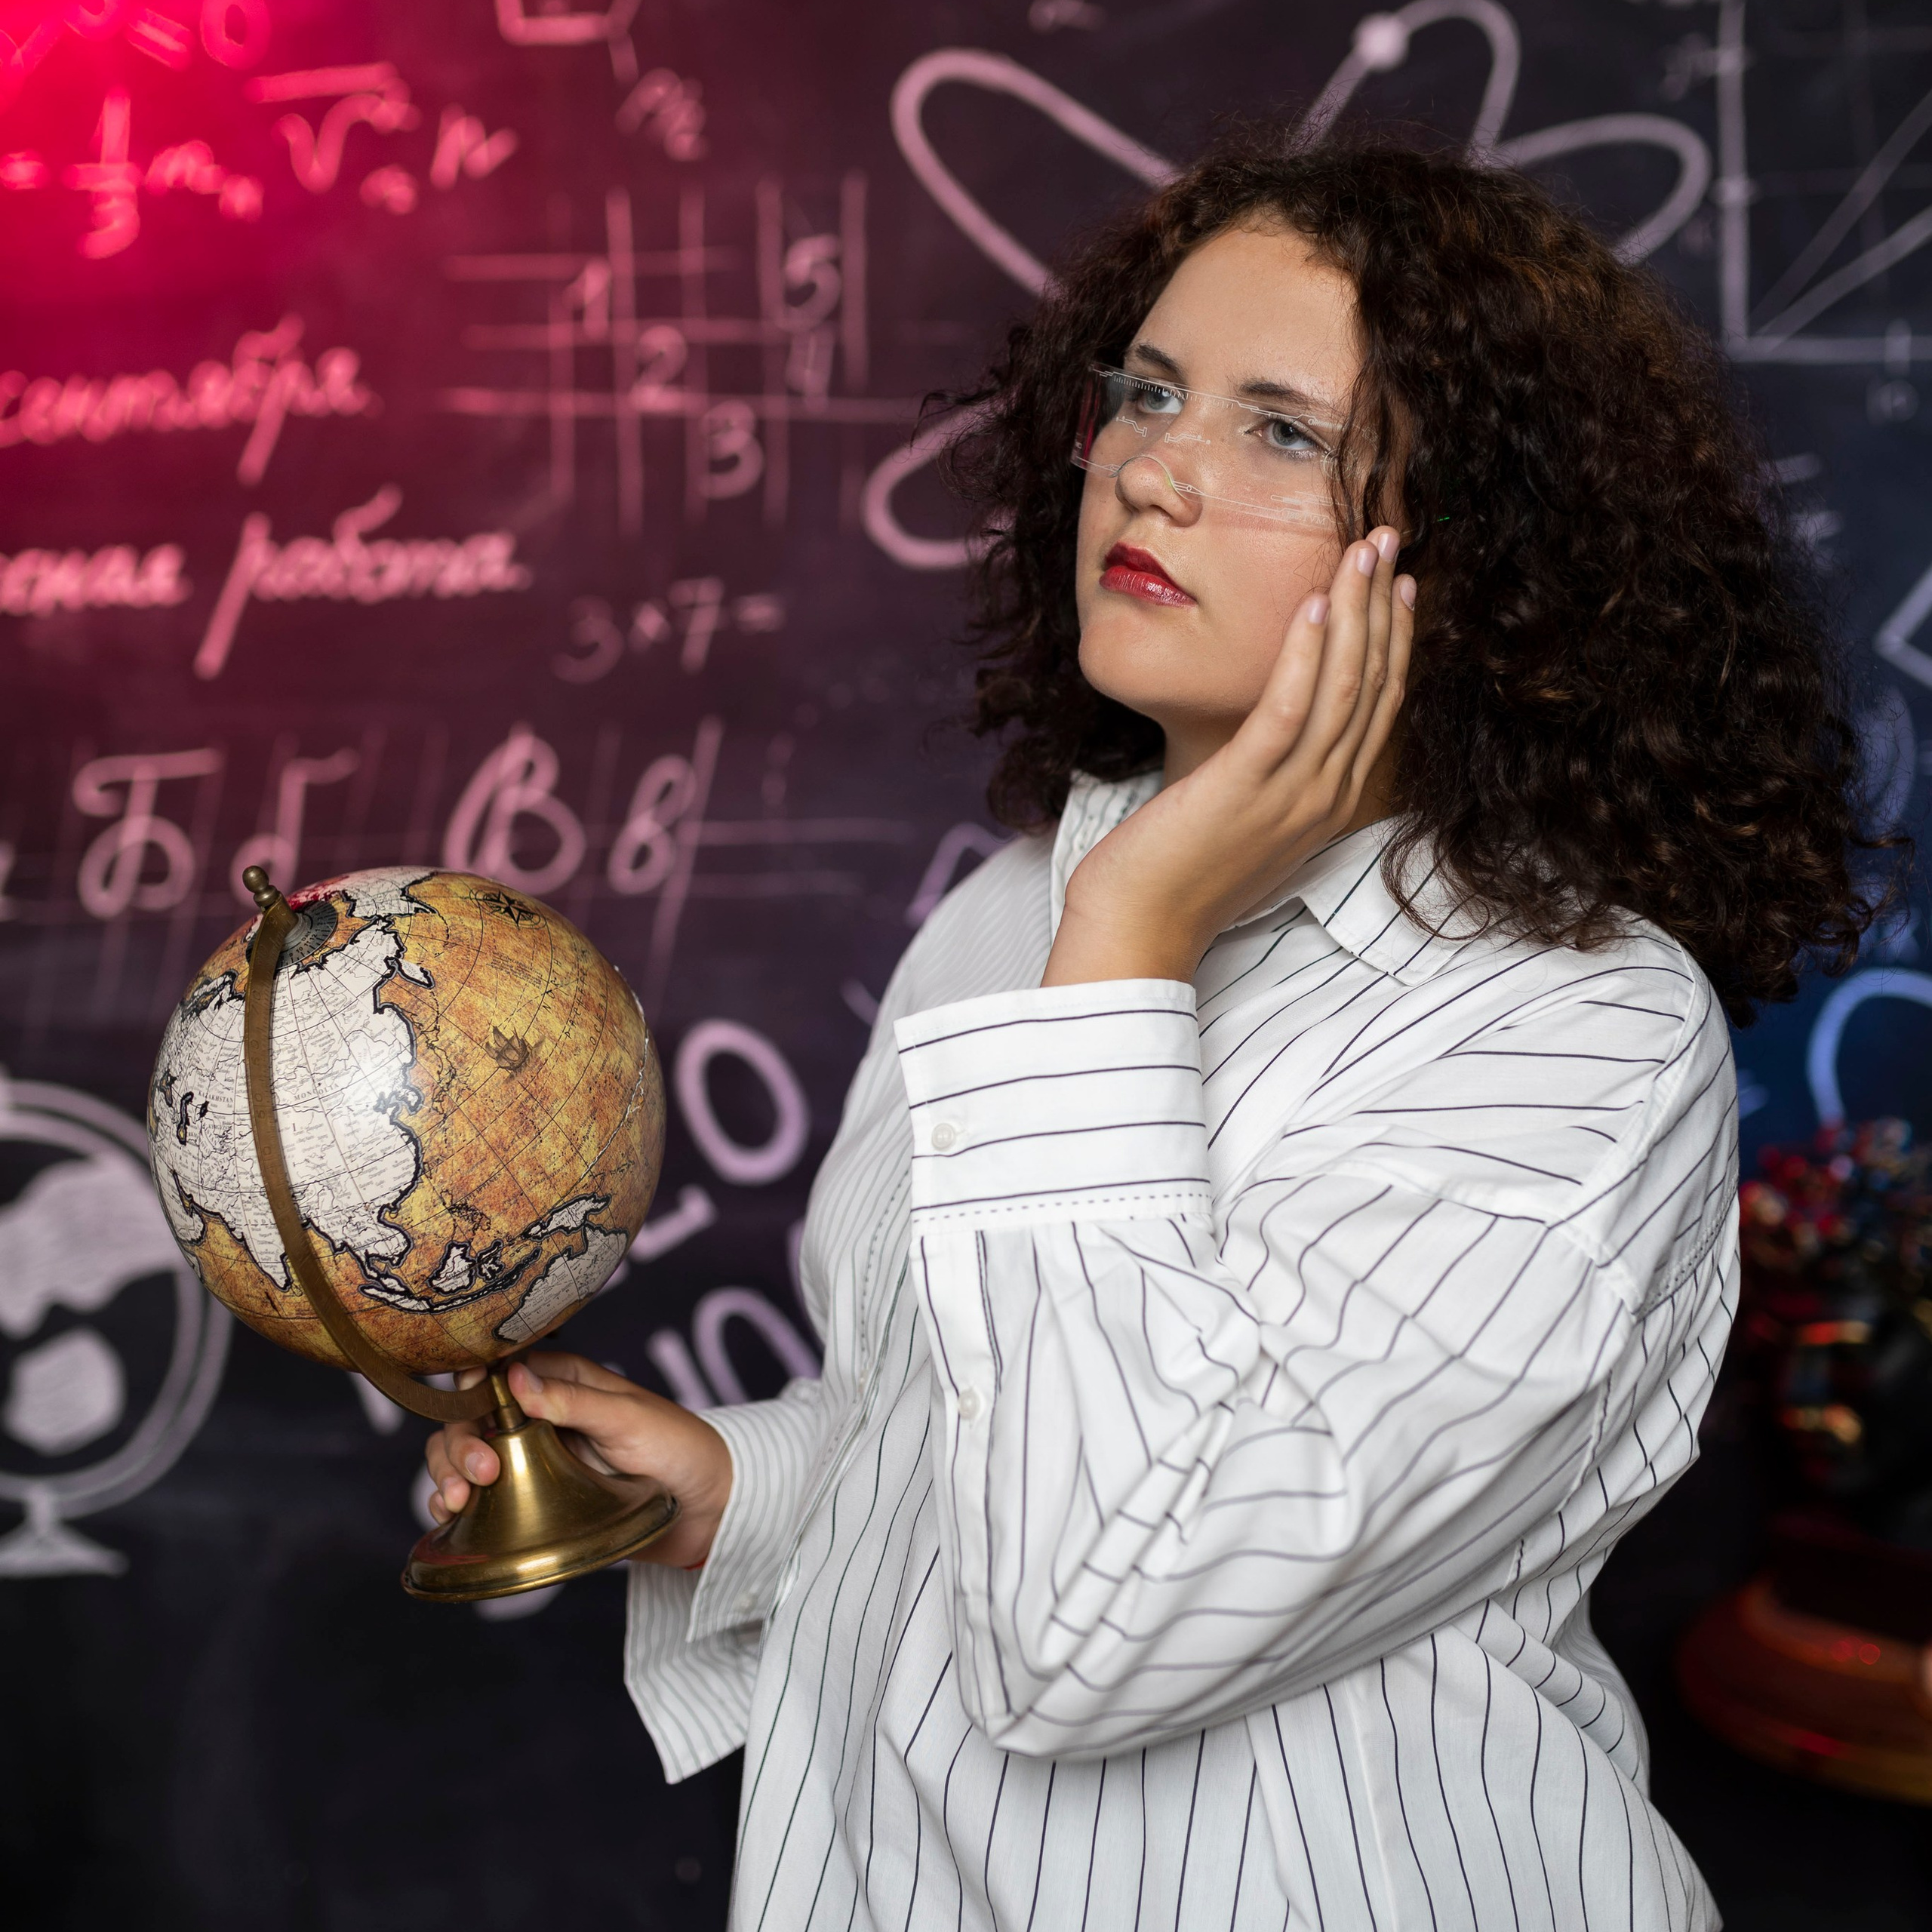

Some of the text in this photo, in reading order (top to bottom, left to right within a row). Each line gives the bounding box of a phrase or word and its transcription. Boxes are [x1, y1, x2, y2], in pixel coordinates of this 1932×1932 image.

[629, 325, 691, 412] 2
[702, 400, 764, 499] 3
[194, 481, 532, 678] работа
[73, 748, 220, 918] Б
[444, 721, 586, 896] В
[608, 755, 697, 894] в
[294, 1084, 339, 1101] MONGOLIA
